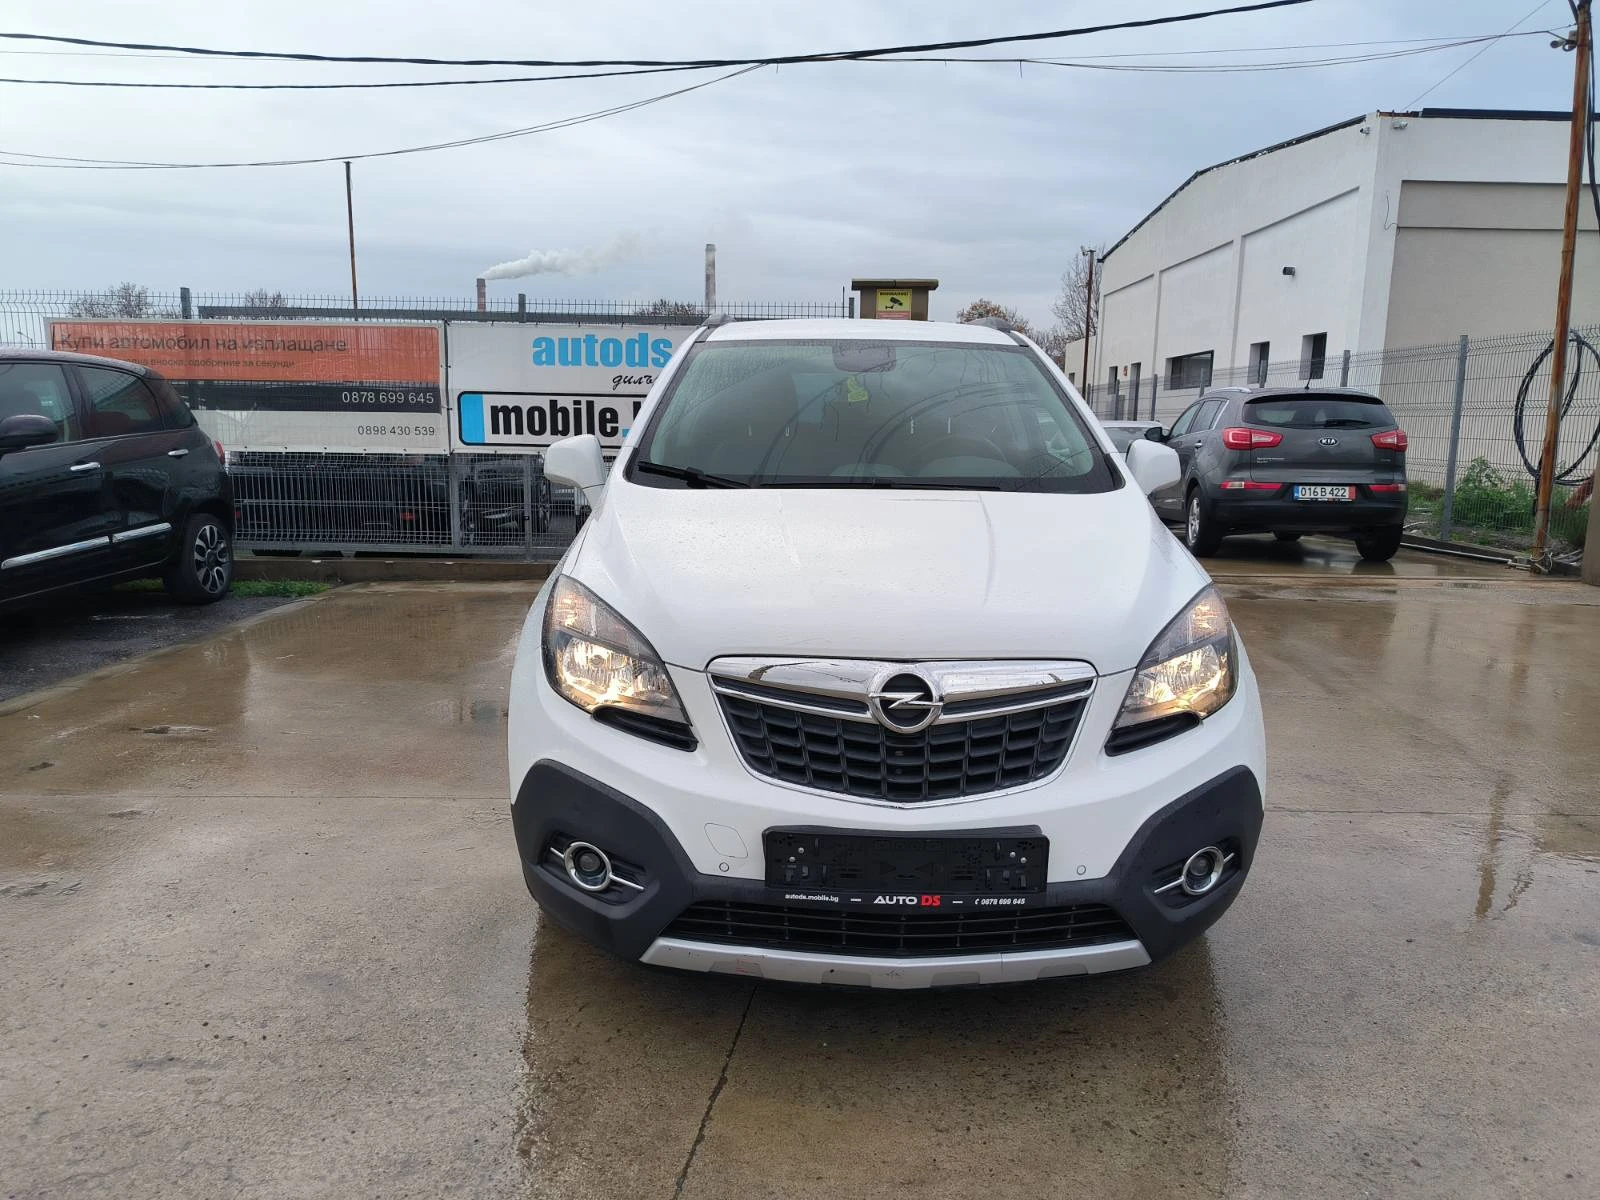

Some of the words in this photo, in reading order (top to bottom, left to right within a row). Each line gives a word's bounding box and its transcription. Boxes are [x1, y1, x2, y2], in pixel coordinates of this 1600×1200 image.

[61, 334, 104, 351] Купи
[110, 335, 210, 350] автомобил
[216, 338, 237, 350] на
[243, 339, 347, 353] изплащане
[533, 333, 672, 368] autods
[612, 374, 657, 391] дилъ
[342, 391, 375, 404] 0878
[379, 391, 404, 404] 699
[408, 392, 434, 404] 645
[357, 425, 387, 435] 0898
[389, 426, 411, 435] 430
[414, 426, 435, 436] 539
[1300, 487, 1319, 497] 016
[1320, 487, 1327, 497] B
[1328, 487, 1347, 497] 422
[785, 893, 839, 903] autods.mobile.bg
[873, 895, 918, 905] AUTO
[920, 895, 941, 906] DS
